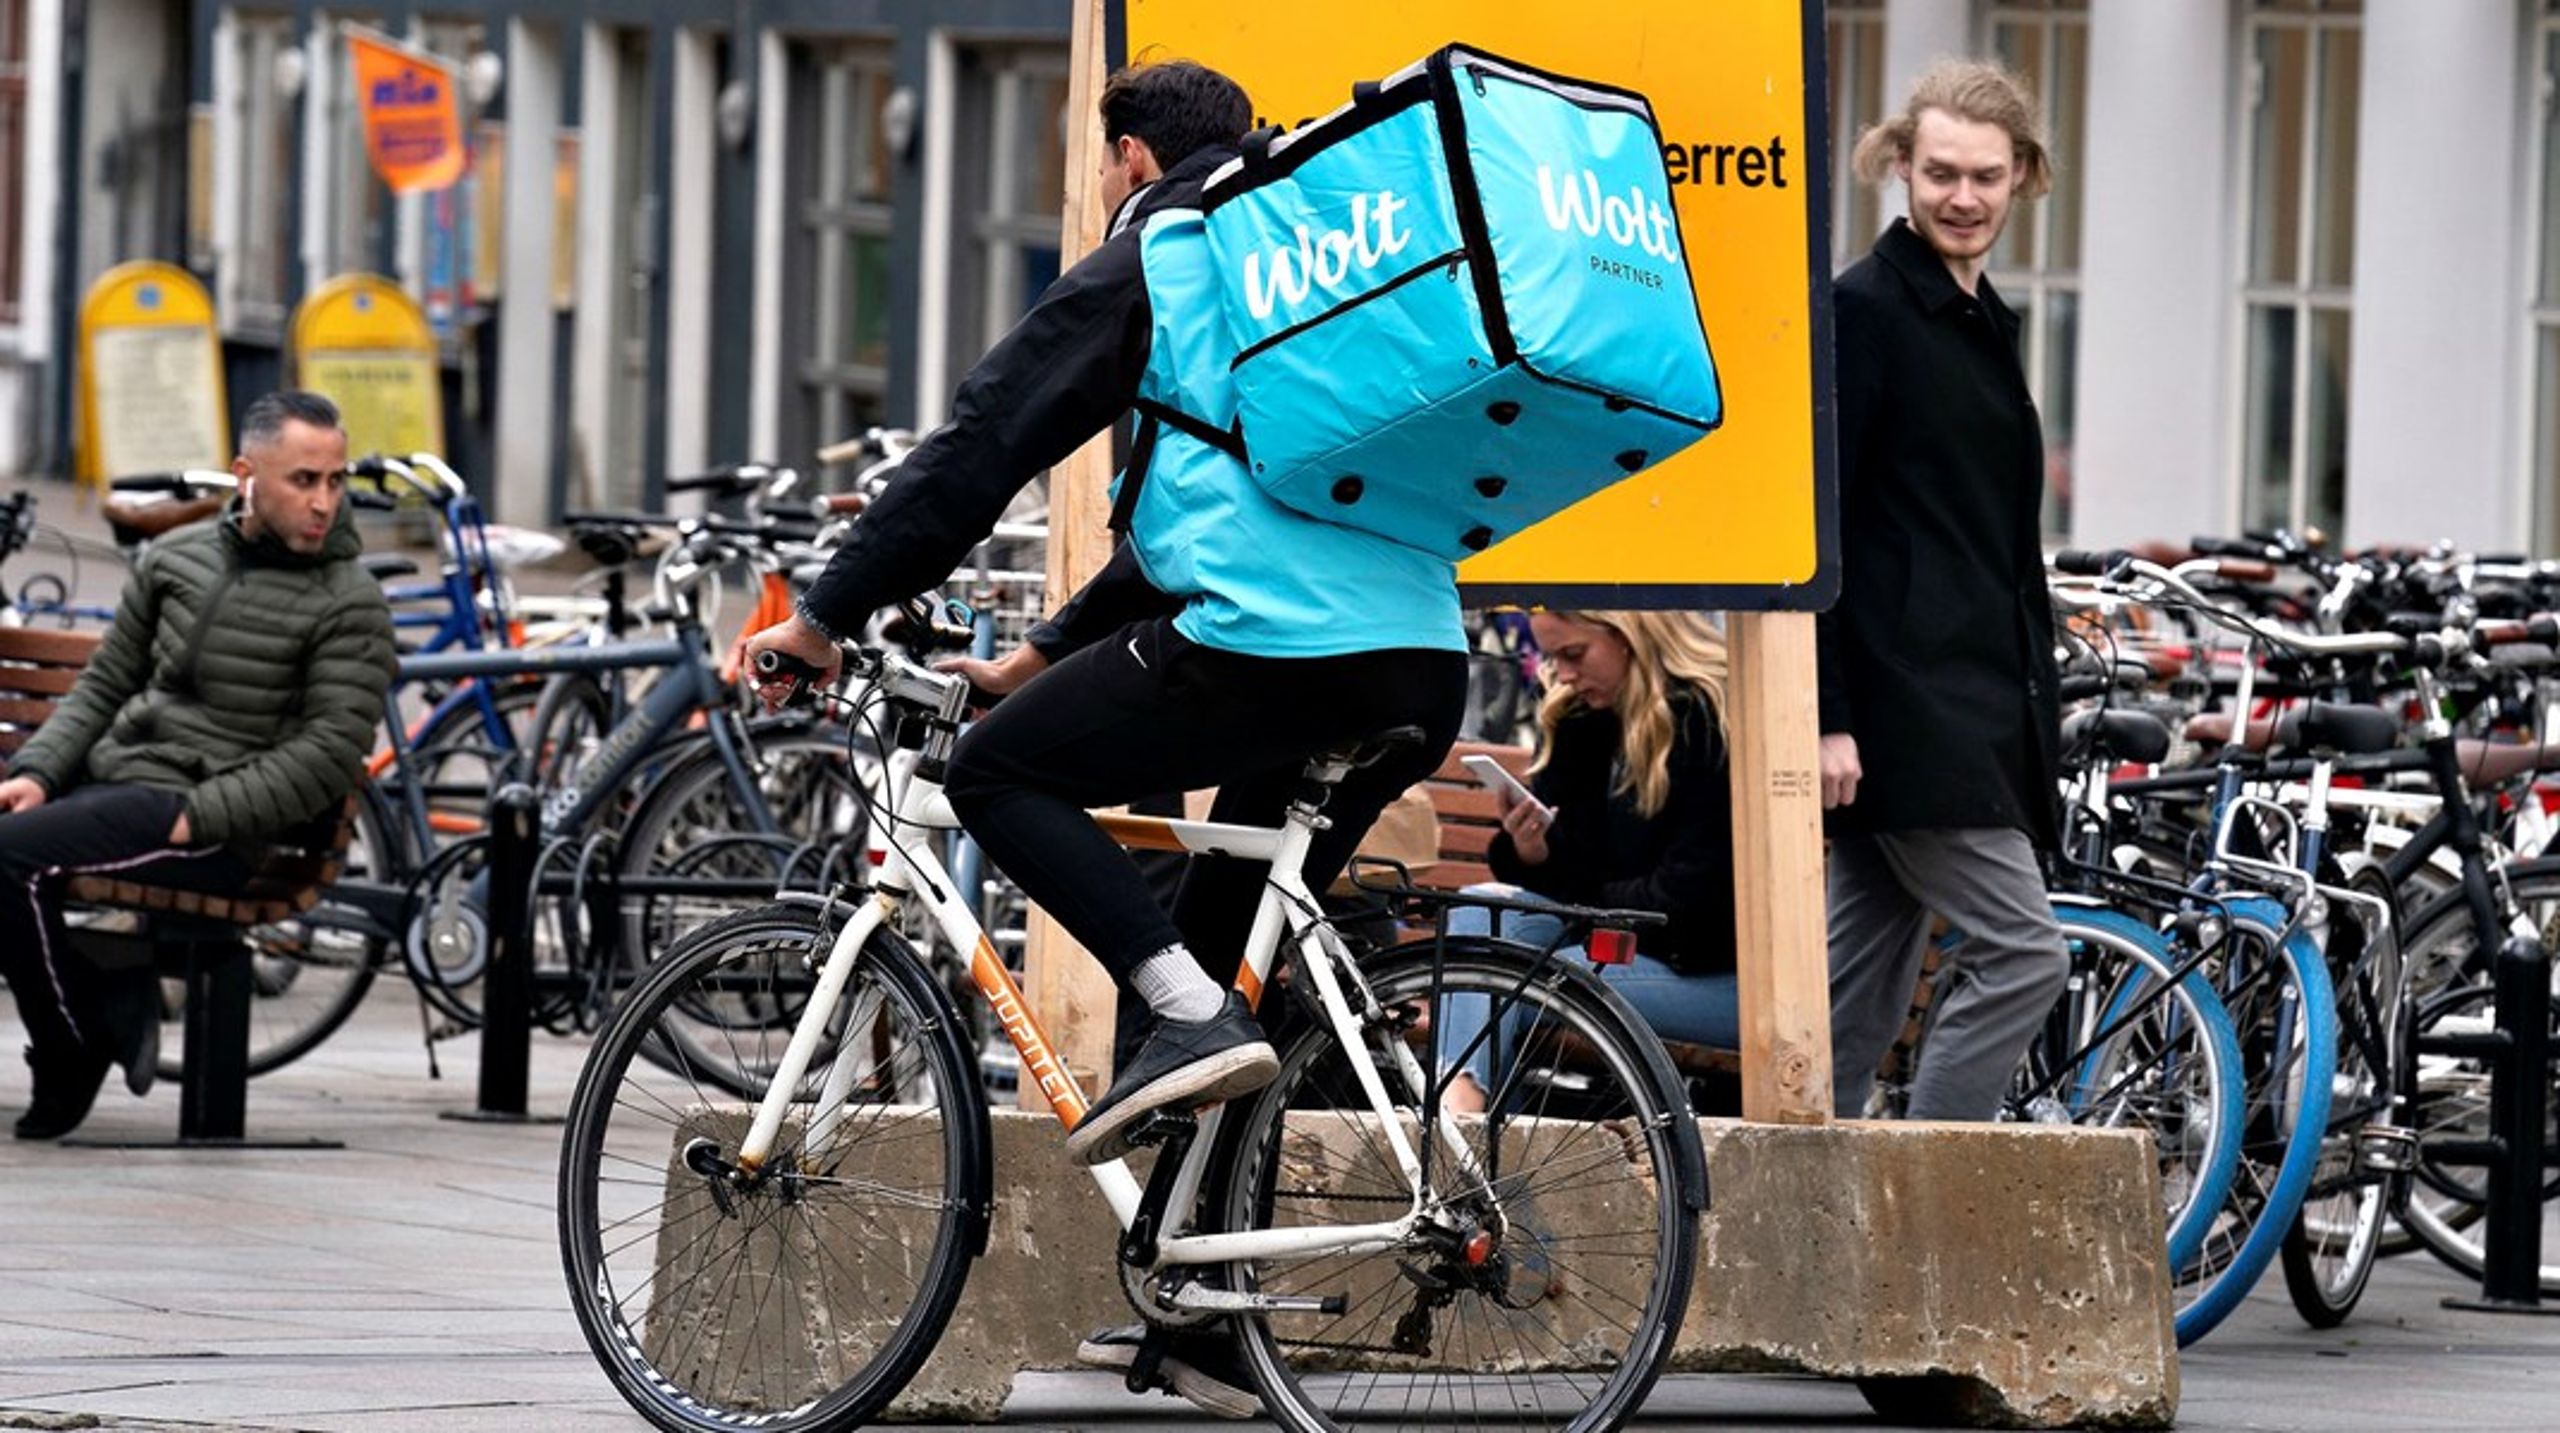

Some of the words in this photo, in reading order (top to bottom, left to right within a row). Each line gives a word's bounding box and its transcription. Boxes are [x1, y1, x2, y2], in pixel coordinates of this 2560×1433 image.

[1662, 135, 1787, 188] erret
[1537, 165, 1677, 263] Wolt
[1244, 190, 1411, 319] Wolt
[1591, 256, 1664, 290] PARTNER
